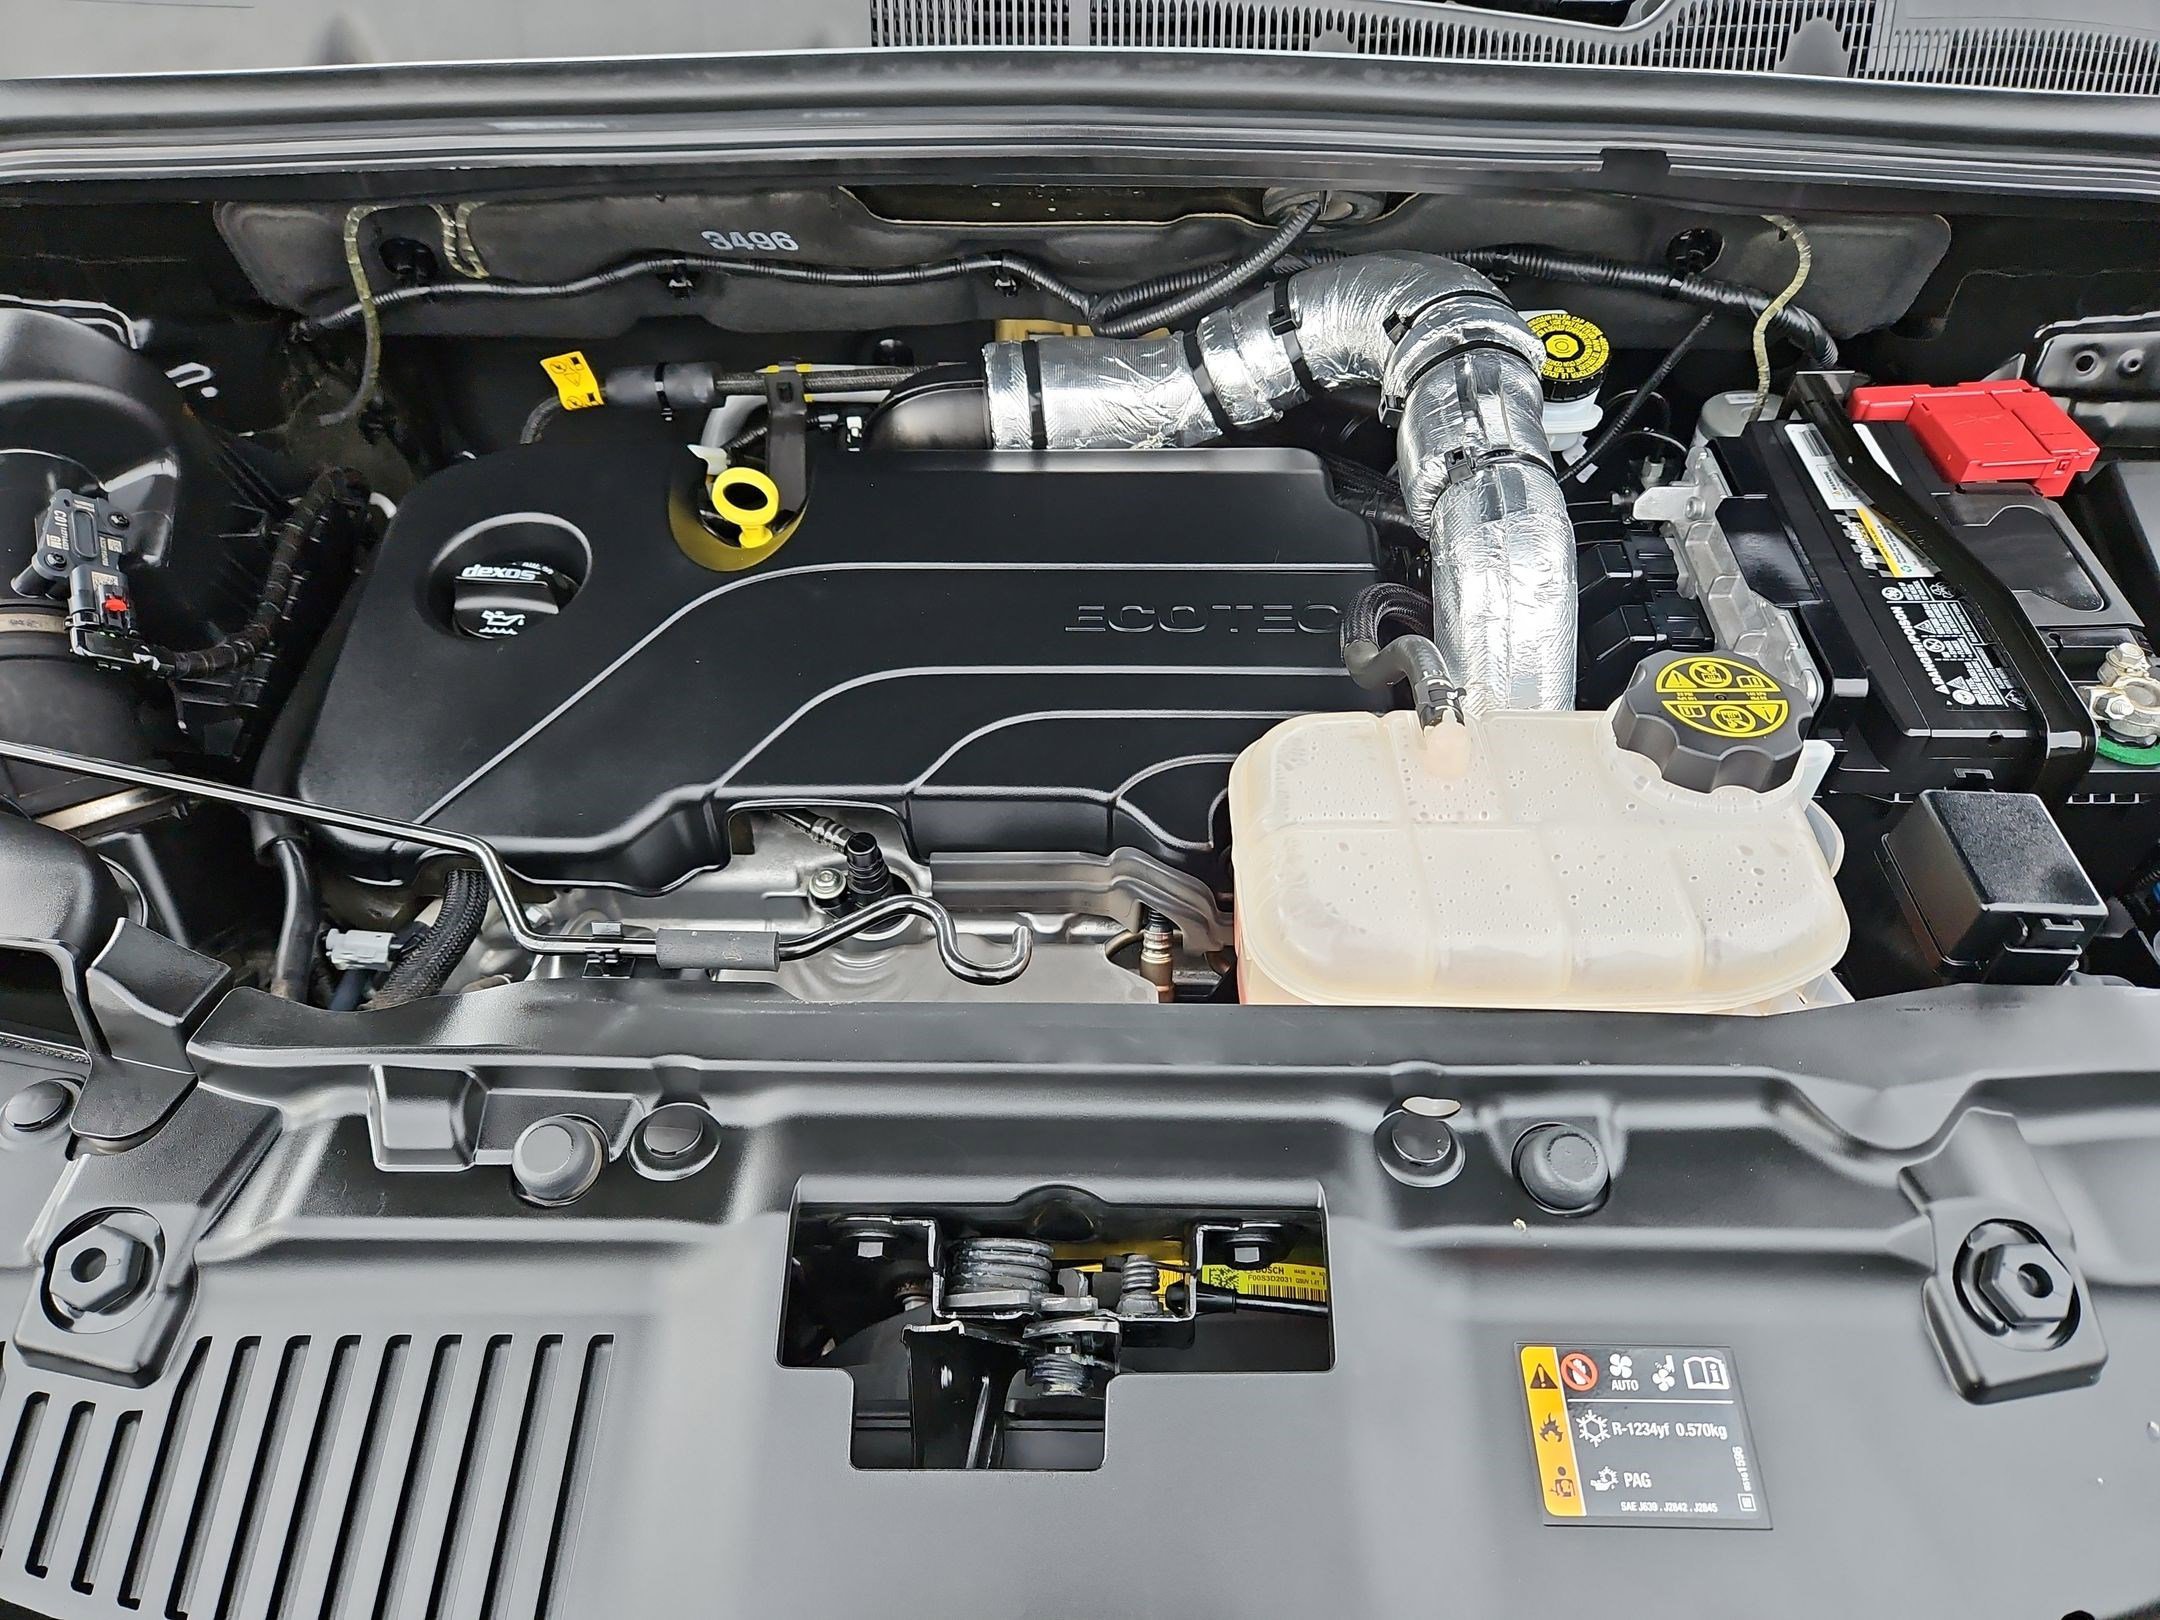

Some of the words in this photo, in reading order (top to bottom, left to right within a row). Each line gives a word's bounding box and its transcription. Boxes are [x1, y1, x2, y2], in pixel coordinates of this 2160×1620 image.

[701, 231, 798, 250] 3496
[461, 564, 541, 581] dexos
[1065, 605, 1342, 633] ECOTEC
[1890, 606, 1945, 685] DANGER/POISON
[1611, 1379, 1639, 1391] AUTO
[1612, 1422, 1669, 1440] R-1234yf
[1676, 1422, 1727, 1441] 0.570kg
[1623, 1472, 1652, 1489] PAG
[1620, 1501, 1638, 1512] SAE
